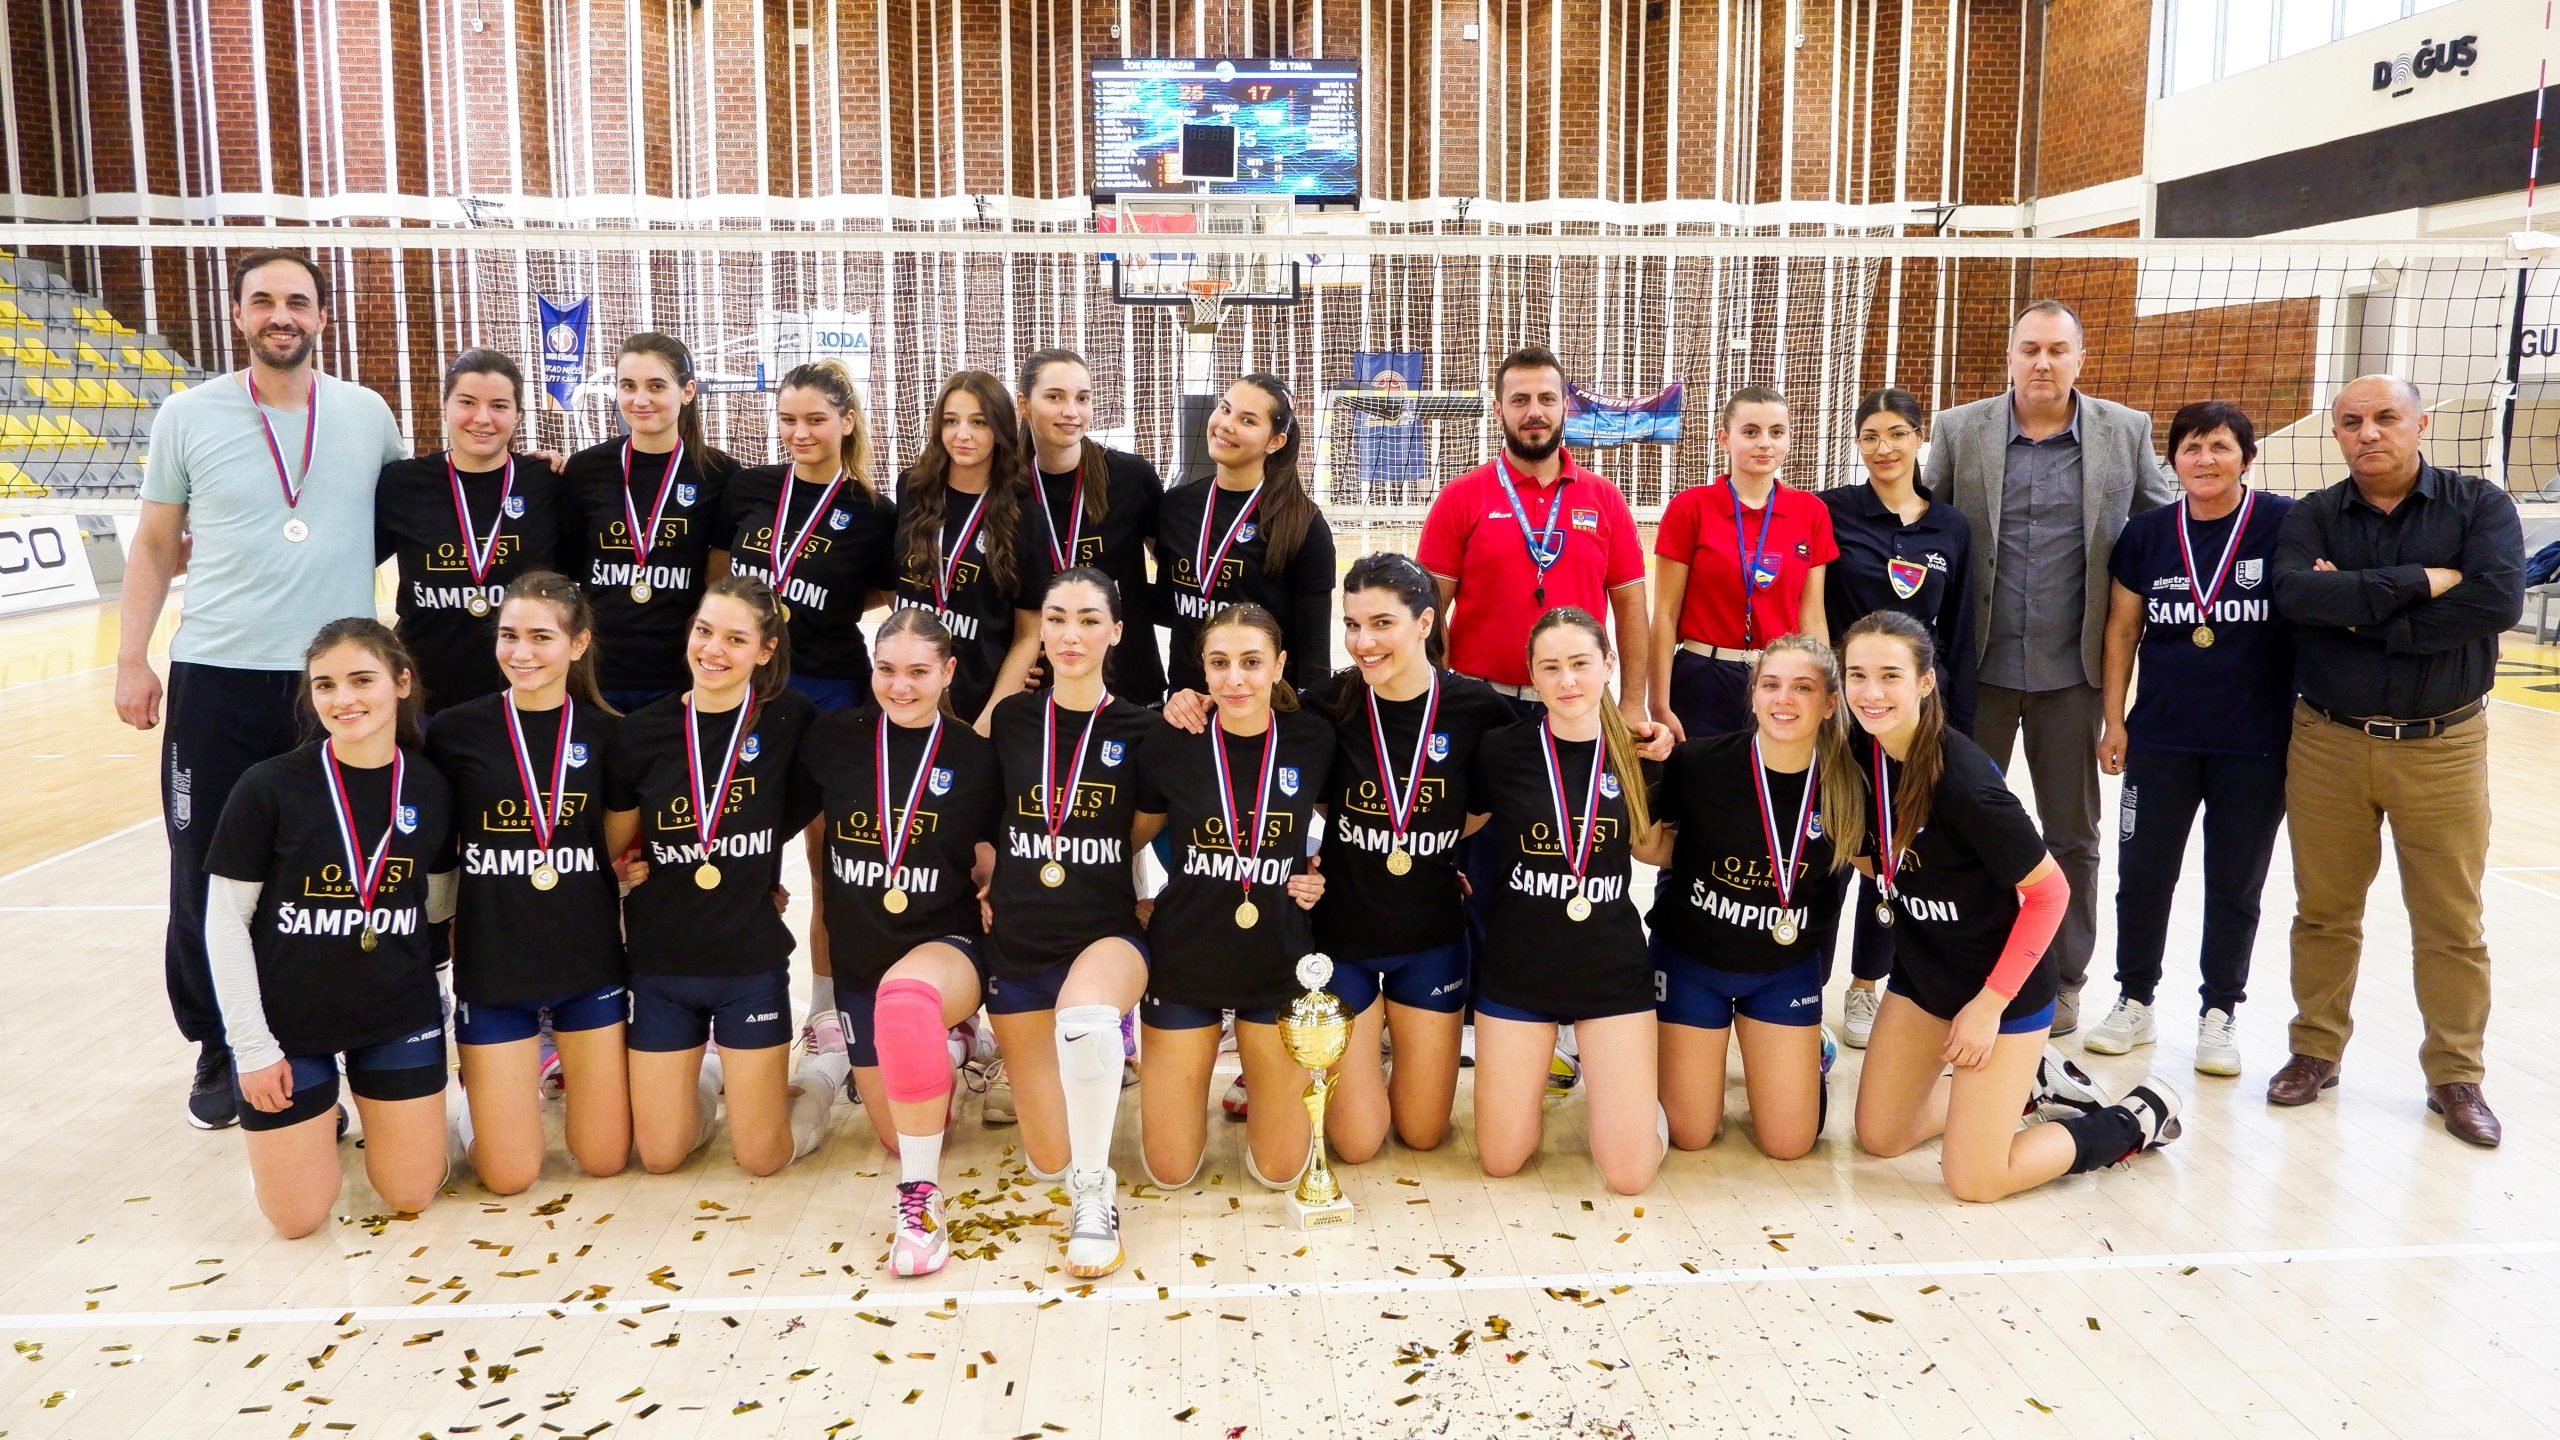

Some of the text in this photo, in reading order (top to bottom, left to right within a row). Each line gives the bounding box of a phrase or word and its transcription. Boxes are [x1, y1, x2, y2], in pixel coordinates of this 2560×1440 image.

[1289, 62, 1312, 70] TARA
[1180, 84, 1204, 101] 25
[1248, 85, 1272, 100] 17
[816, 331, 868, 348] RODA
[610, 521, 677, 539] OS
[757, 527, 819, 552] OS
[438, 541, 508, 558] OLS
[591, 558, 692, 589] ŠAMPIONI
[1178, 558, 1232, 580] OS
[414, 581, 504, 609] ŠAMPIO
[2148, 598, 2269, 624] ŠAMPIONI
[671, 786, 743, 815] OS
[1359, 780, 1433, 804] OS
[1363, 801, 1428, 813] BOUUE
[1205, 817, 1281, 838] OLS
[1339, 814, 1459, 856] ŠAMPIONI
[1531, 822, 1606, 843] OIS
[651, 828, 773, 864] ŠAMPIONI
[1009, 826, 1121, 865] ŠAMPIONI
[321, 864, 402, 883] OS
[831, 845, 939, 893] ŠAMPIONI
[1724, 856, 1789, 878] OLI
[326, 885, 394, 893] BOUUE
[1509, 861, 1623, 903] ŠAMPIONI
[1727, 874, 1778, 887] BOUTIQU
[1690, 878, 1808, 930] ŠAMPIONI
[278, 902, 417, 936] ŠAMPIONI
[757, 1012, 779, 1022] ARDU
